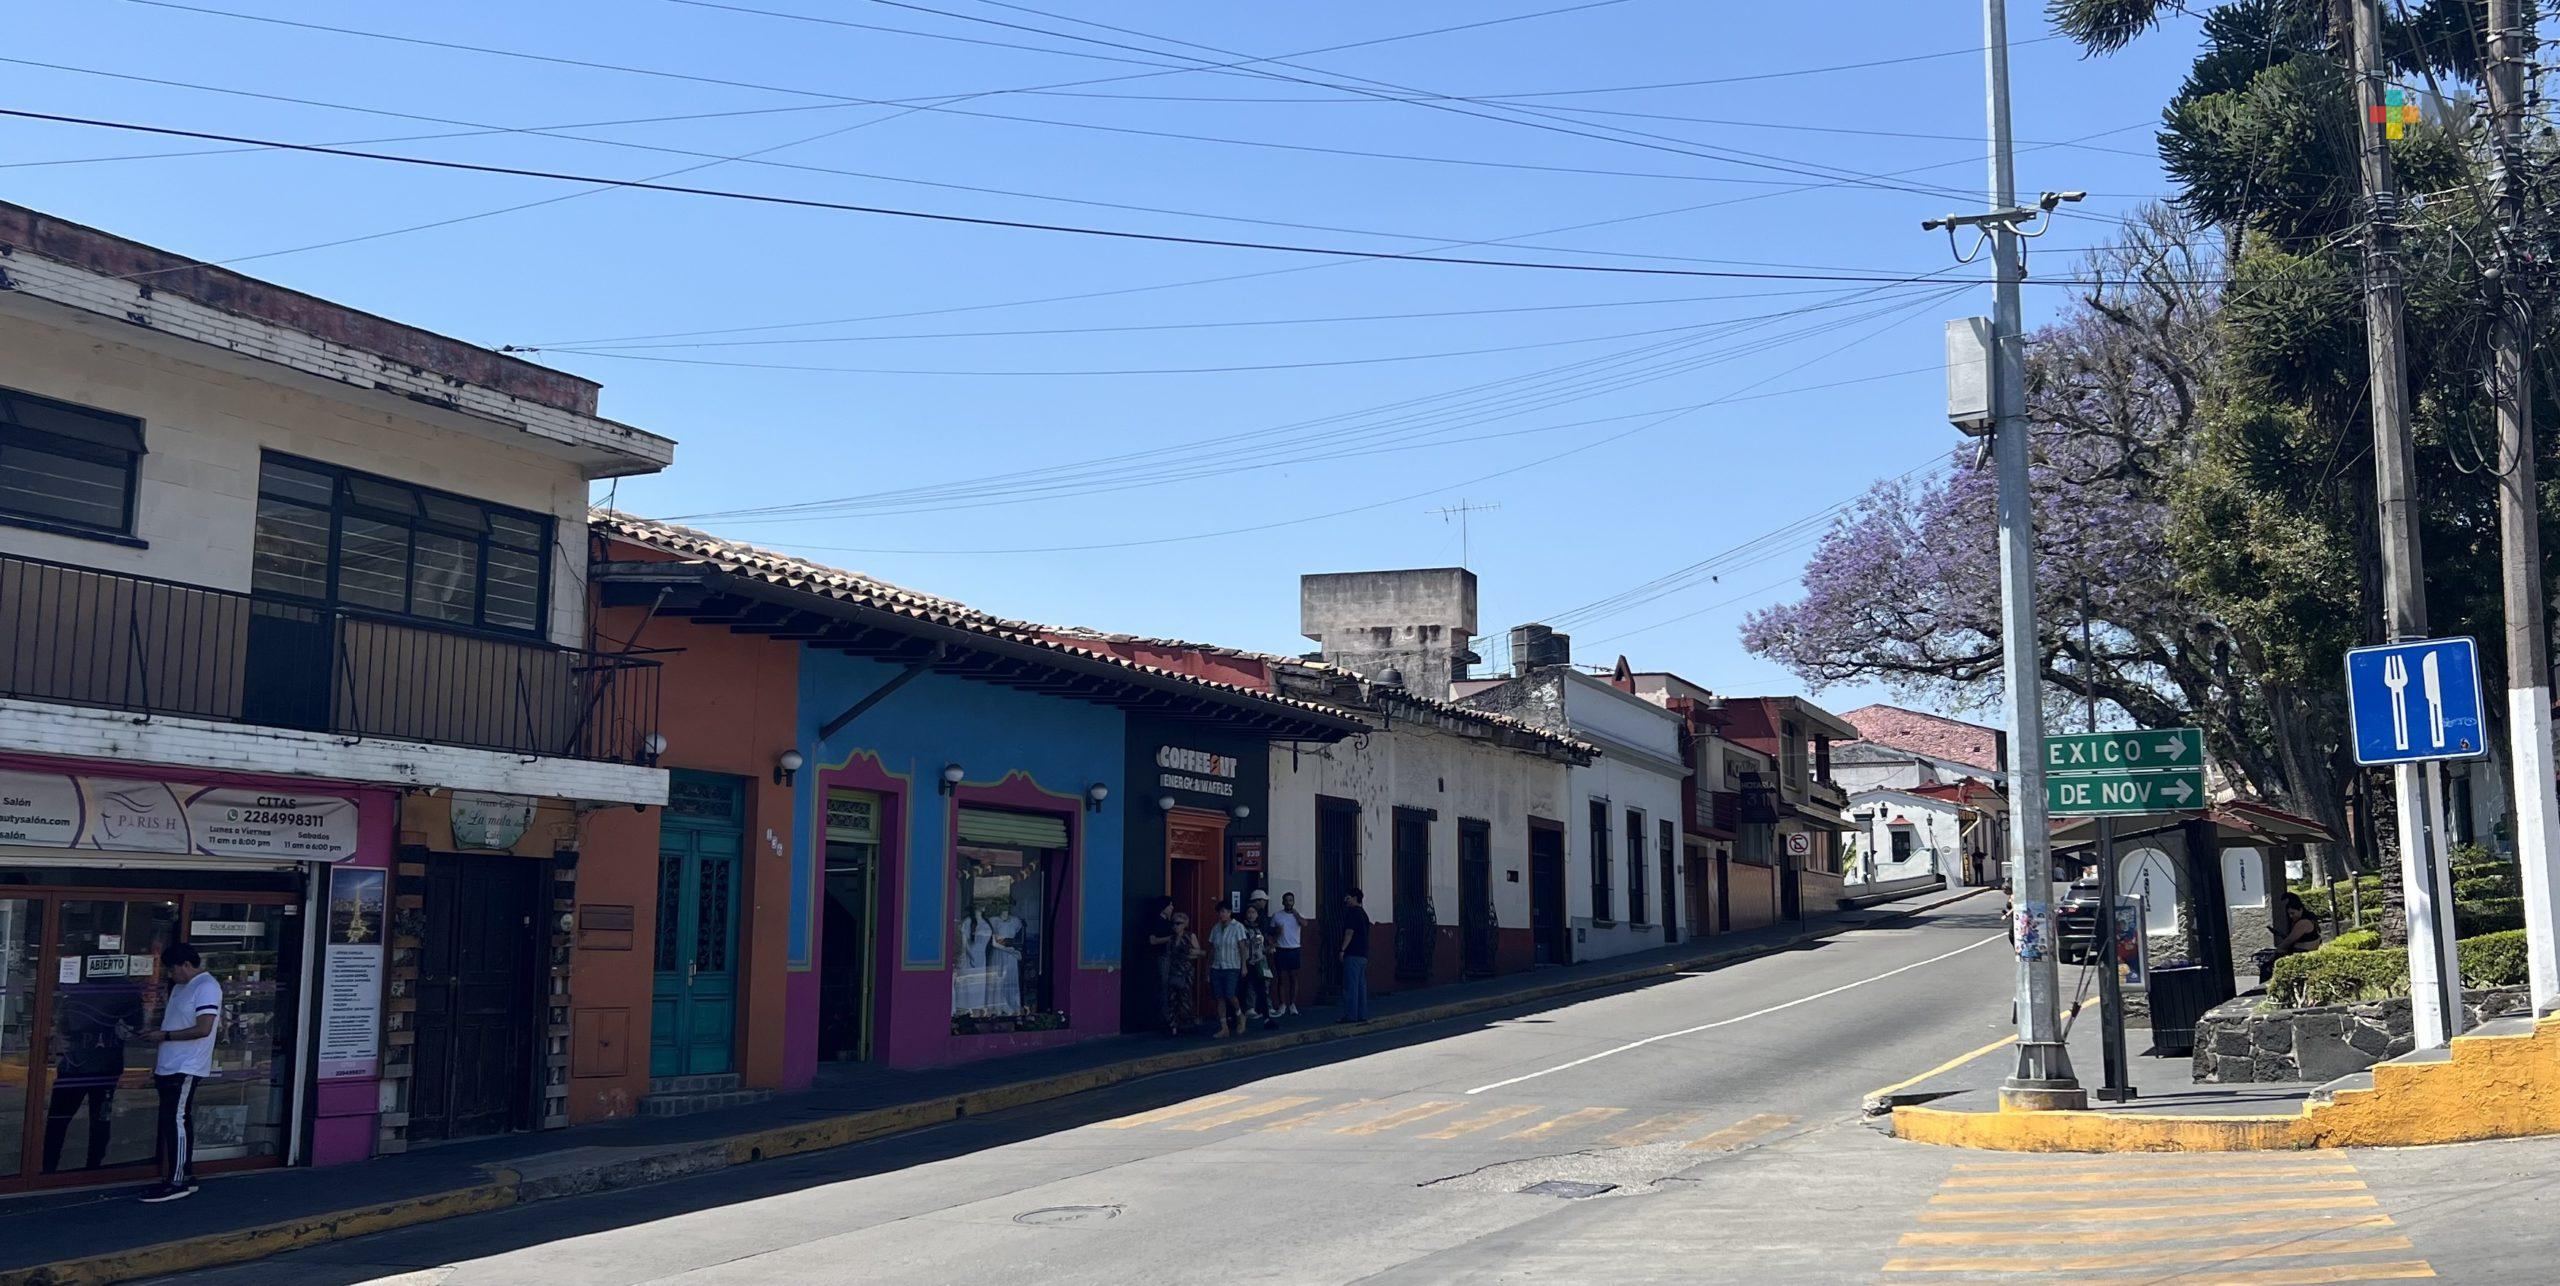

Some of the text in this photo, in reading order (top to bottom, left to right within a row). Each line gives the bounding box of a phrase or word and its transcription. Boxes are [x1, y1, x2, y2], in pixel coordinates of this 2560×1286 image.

[2050, 740, 2141, 764] EXICO
[1201, 780, 1233, 796] WAFFLES
[2061, 784, 2091, 805] DE
[2102, 782, 2153, 804] NOV
[3, 797, 31, 807] Salón
[257, 796, 297, 809] CITAS
[244, 810, 324, 827] 2284998311
[209, 826, 233, 834] Lunes
[241, 827, 271, 836] Viernes
[90, 959, 125, 971] ABIERTO
